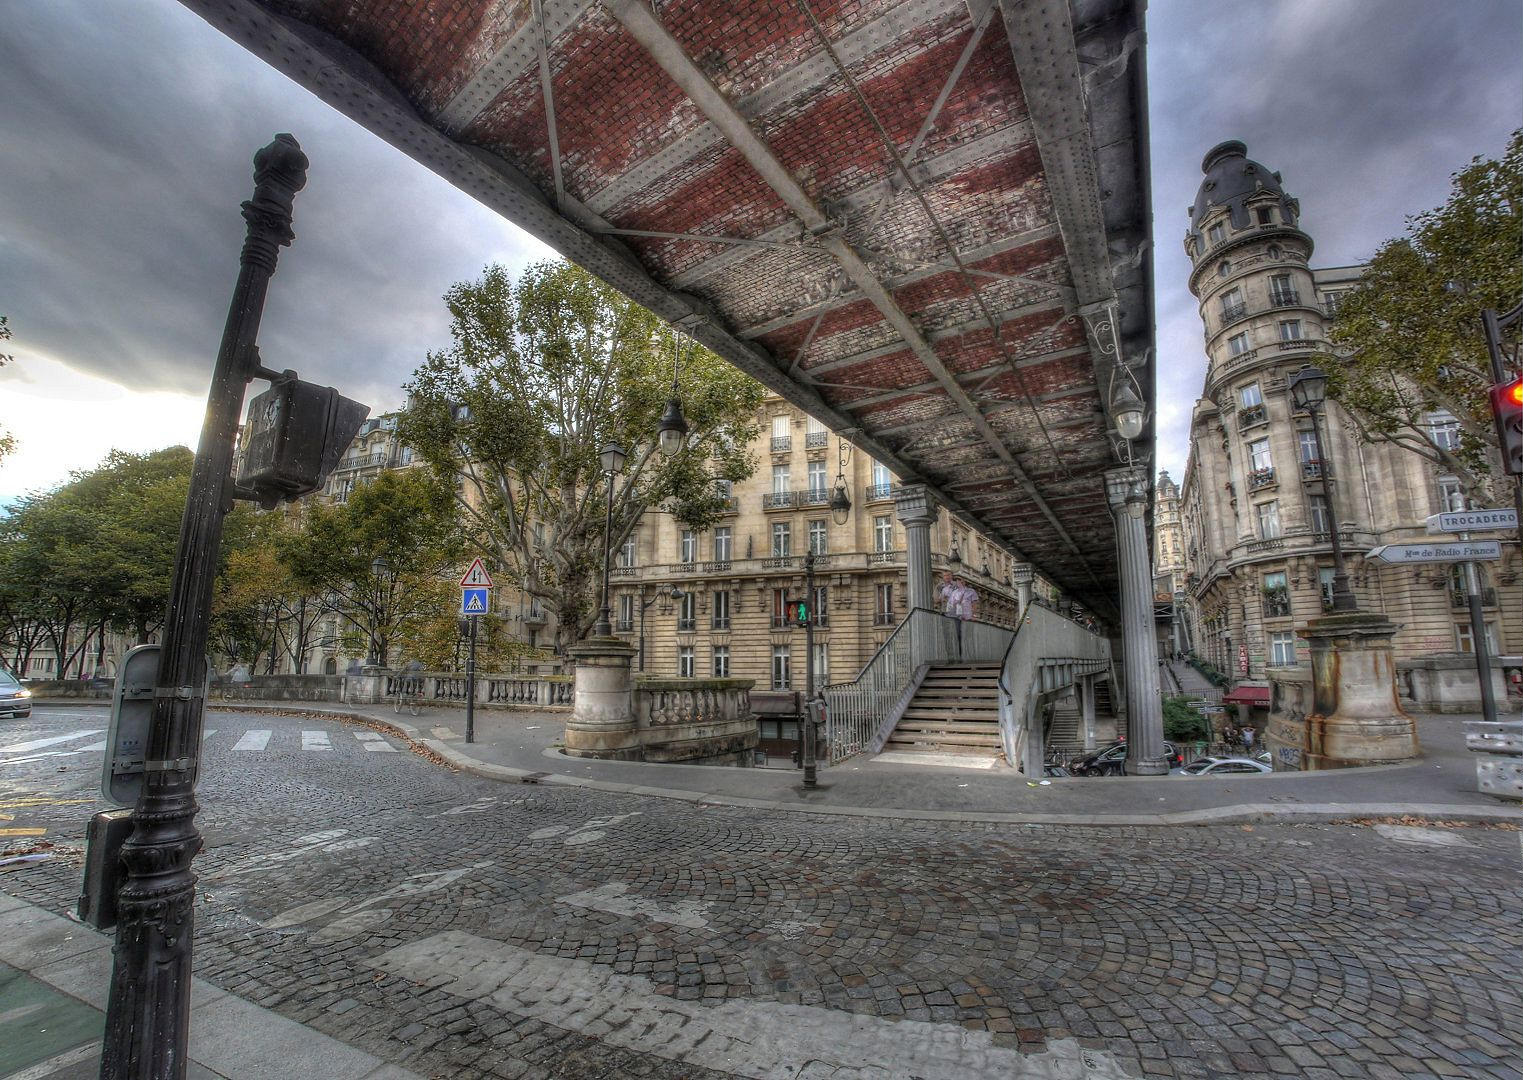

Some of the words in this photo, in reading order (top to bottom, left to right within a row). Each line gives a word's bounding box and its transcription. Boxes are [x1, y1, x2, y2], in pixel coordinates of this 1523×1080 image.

[1421, 549, 1433, 557] de
[1435, 548, 1461, 557] Radio
[1463, 547, 1496, 556] France
